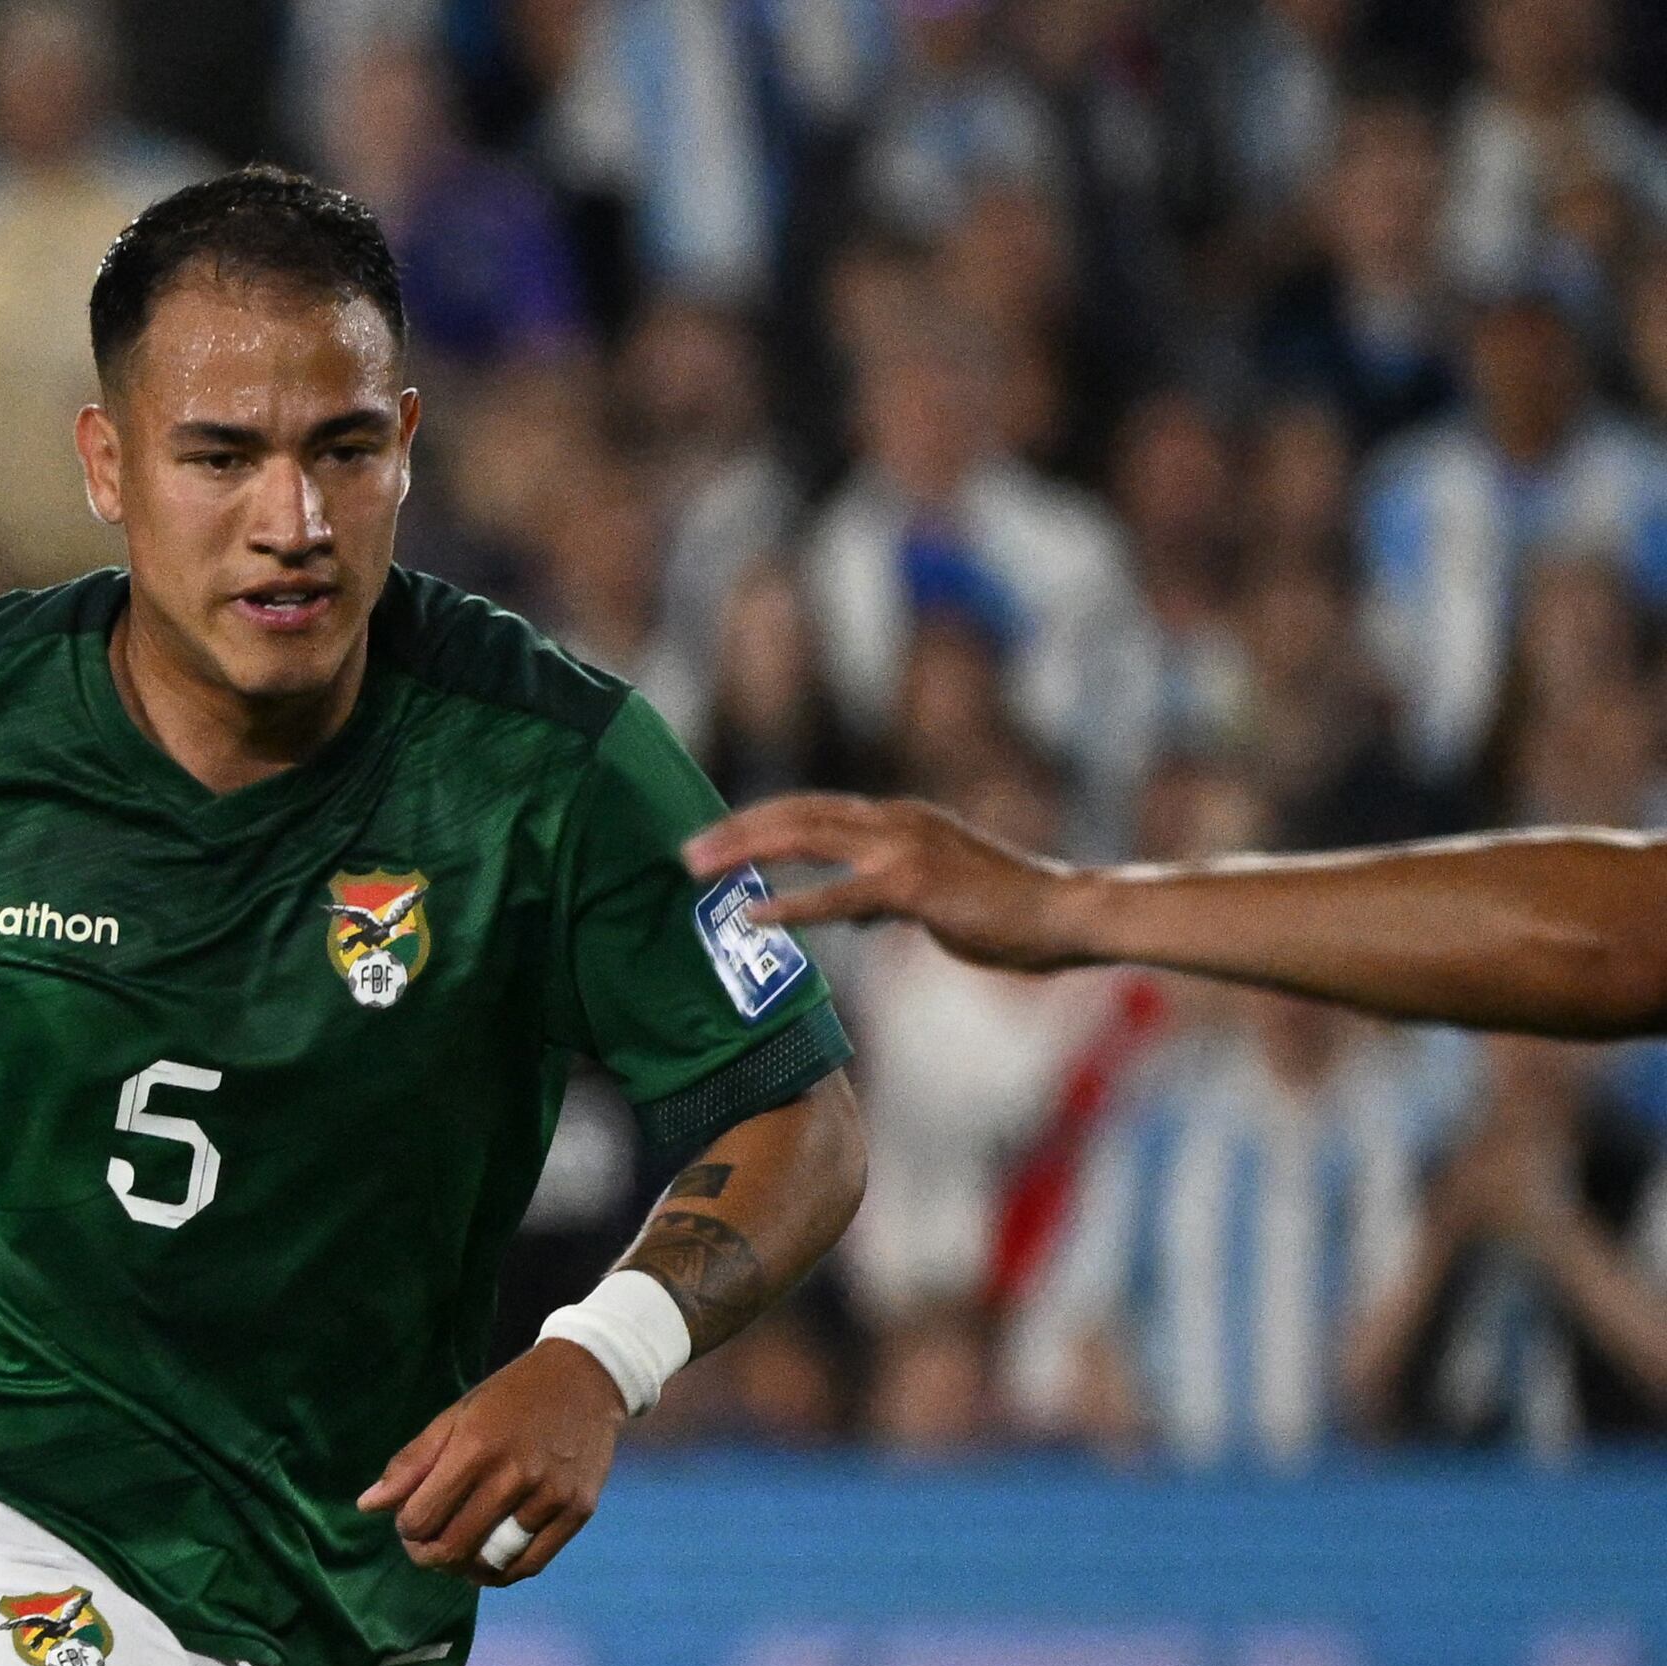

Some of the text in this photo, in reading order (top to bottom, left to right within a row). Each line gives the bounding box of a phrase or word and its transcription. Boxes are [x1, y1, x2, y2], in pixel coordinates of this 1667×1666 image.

[709, 881, 750, 928] FOOTBALL
[360, 964, 394, 994] FBF
[107, 1060, 222, 1229] 5
